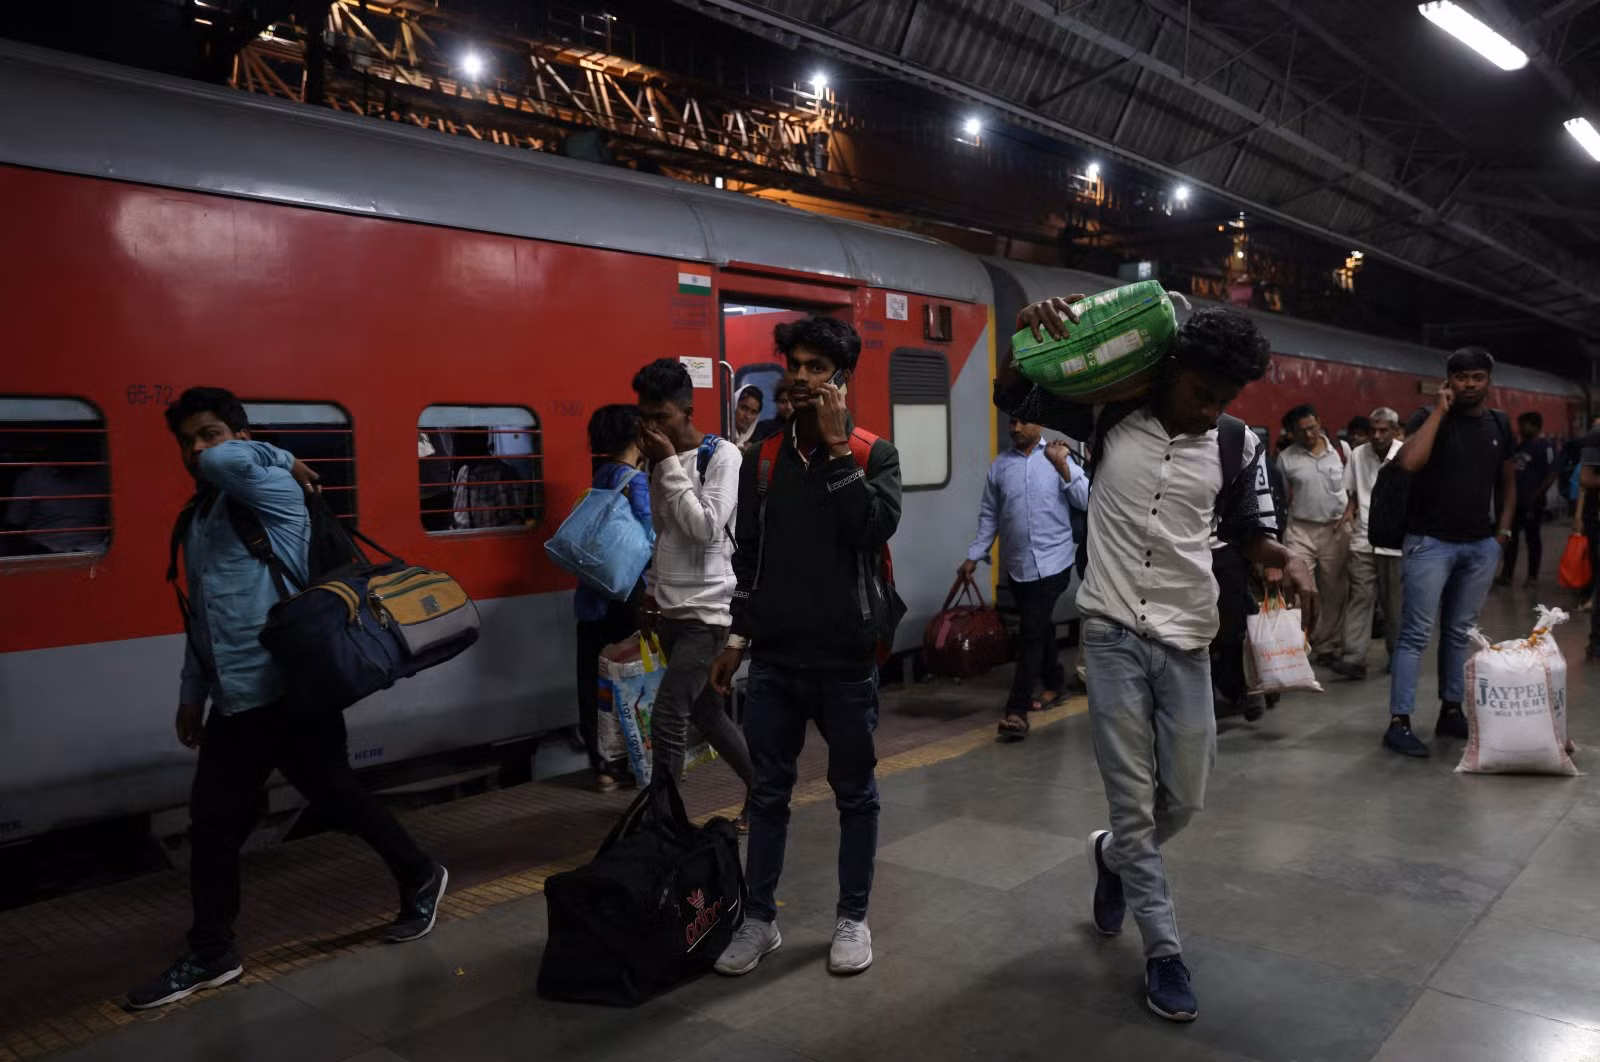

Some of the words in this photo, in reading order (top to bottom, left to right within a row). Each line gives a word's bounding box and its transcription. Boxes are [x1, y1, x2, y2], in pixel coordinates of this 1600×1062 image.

[127, 383, 173, 405] 65-72
[1476, 677, 1546, 706] JAYPEE
[1489, 697, 1546, 709] CEMENT
[622, 701, 632, 720] TOP
[630, 732, 644, 761] TOWN
